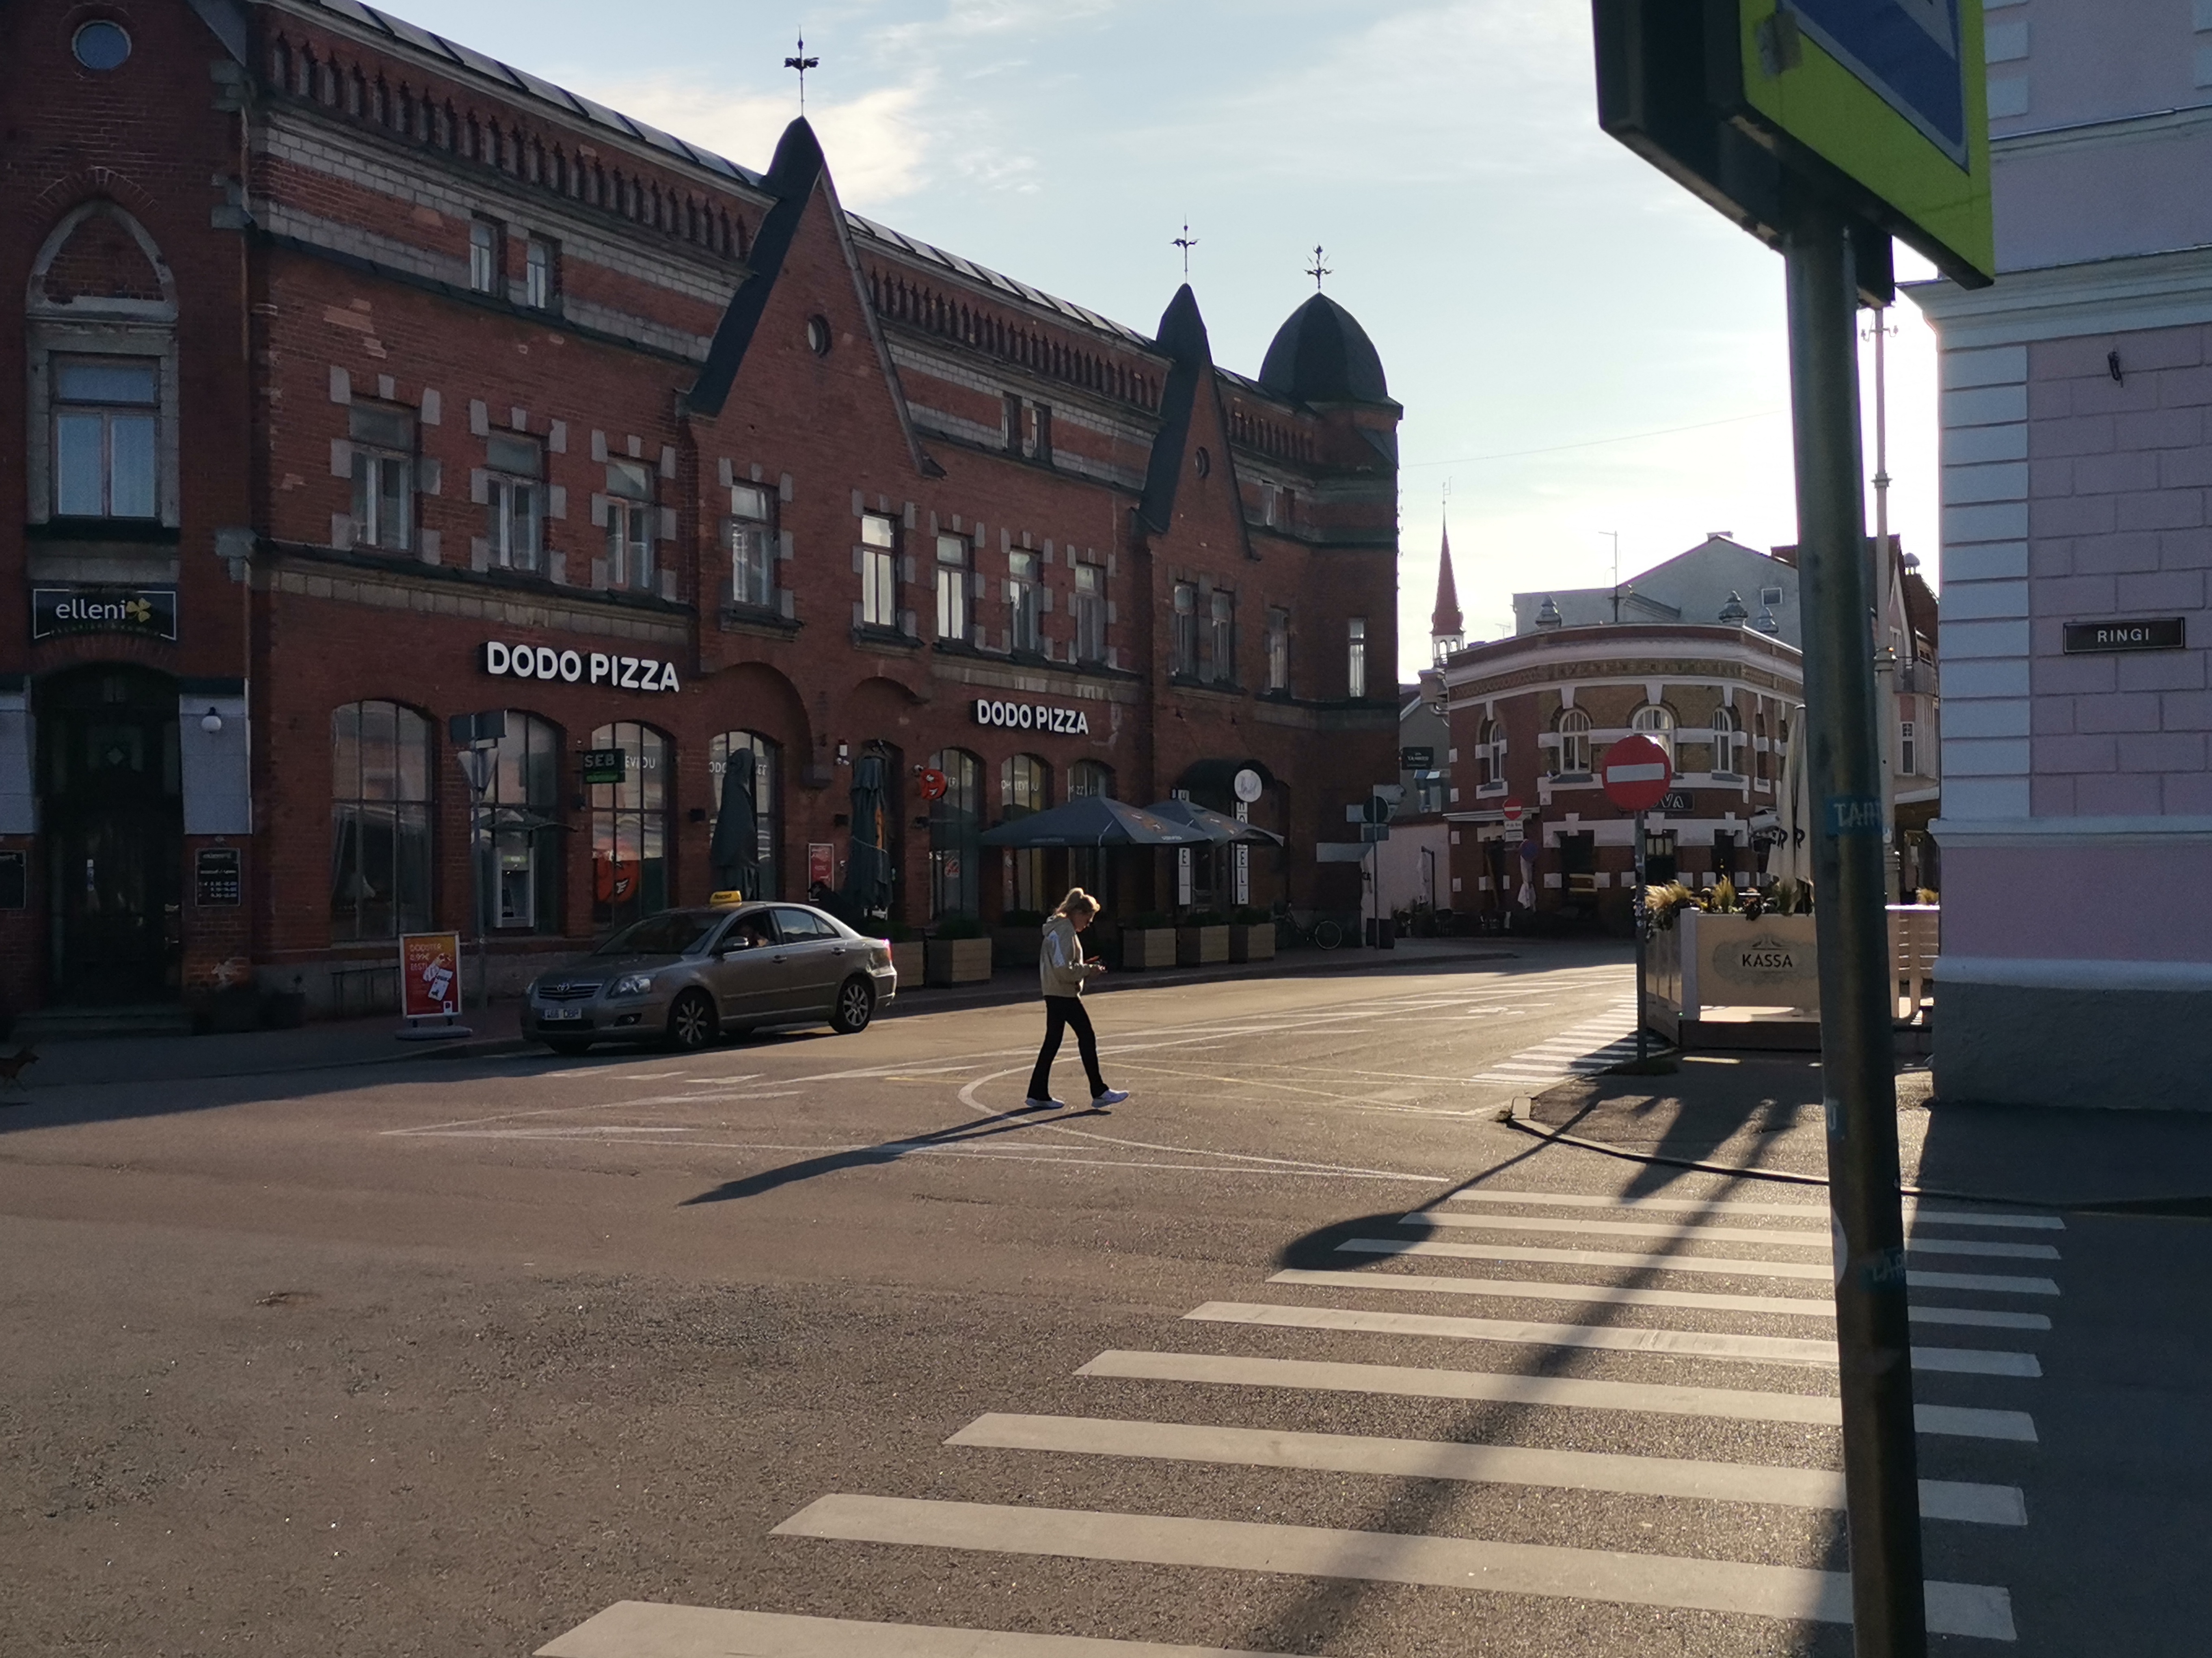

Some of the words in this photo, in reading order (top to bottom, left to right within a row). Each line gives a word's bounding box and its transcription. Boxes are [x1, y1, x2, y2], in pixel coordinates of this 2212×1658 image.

[55, 598, 125, 620] elleni
[2097, 627, 2150, 643] RINGI
[487, 641, 582, 682] DODO
[590, 652, 680, 693] PIZZA
[977, 699, 1032, 729] DODO
[1036, 705, 1089, 735] PIZZA
[584, 753, 616, 768] SEB
[1742, 953, 1793, 968] KASSA
